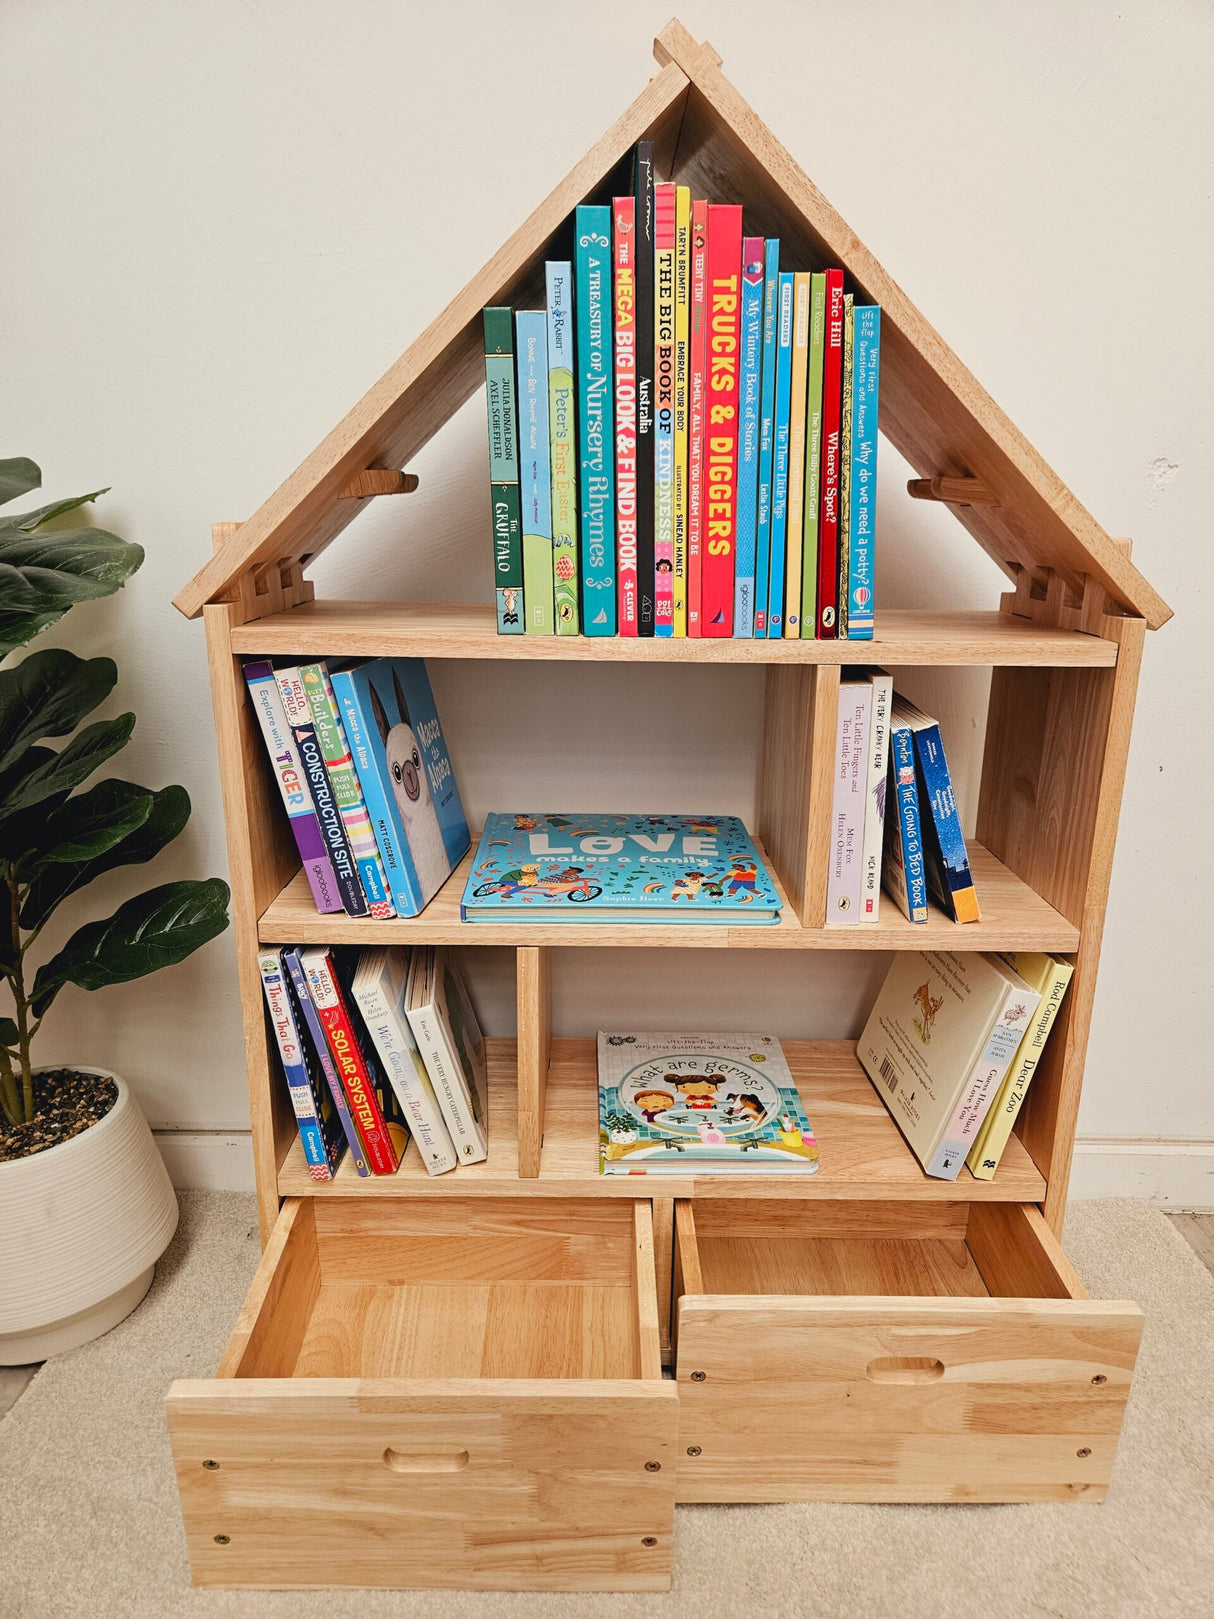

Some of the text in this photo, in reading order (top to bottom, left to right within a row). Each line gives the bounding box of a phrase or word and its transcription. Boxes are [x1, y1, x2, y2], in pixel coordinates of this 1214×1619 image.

[551, 277, 564, 306] PETER
[678, 227, 686, 305] TARYN BRUMFITT
[694, 282, 704, 303] TINY
[696, 252, 704, 280] TEENY
[765, 280, 775, 344] Whoever You Are
[813, 292, 823, 345] First Readers
[830, 287, 842, 348] Eric Hill
[744, 300, 759, 462] My Wintery Book of Stories
[868, 348, 878, 368] Very
[582, 257, 608, 568] A TREASURY OF Nursery Rhymes
[616, 242, 637, 571] THE MEGA BIG LOOK & FIND BOOK
[639, 376, 652, 434] Australia
[658, 254, 672, 540] THE BIG BOOK OF KINDNESS
[676, 341, 685, 432] EMBRACE YOUR BODY
[858, 340, 867, 438] Questions and Answers
[490, 380, 502, 460] AXEL SCHEFFLER
[501, 378, 512, 461] JULIA DONALDSON
[708, 275, 737, 556] TRUCKS & DIGGERS
[762, 418, 770, 451] Mem Fox
[810, 428, 818, 452] Three
[555, 388, 570, 524] Peter's First Easter
[690, 372, 701, 555] FAMILY, ALL THAT YOU DREAM IT TO BE
[774, 424, 788, 518] The Three Little Pigs
[808, 454, 818, 473] Billy
[824, 431, 838, 523] Where's Spot?
[854, 442, 872, 464] Why
[858, 468, 872, 482] do
[760, 484, 768, 524] Leslie Staub
[808, 499, 816, 520] Gruff
[857, 507, 870, 534] need
[858, 486, 868, 503] we
[496, 502, 510, 572] GRUFFALO
[675, 514, 684, 578] SINEAD HANLEY
[852, 548, 870, 585] potty?
[740, 584, 750, 630] igloobooks
[292, 680, 306, 710] HELLO,
[310, 694, 334, 749] Builders
[855, 704, 864, 720] Ten
[878, 690, 886, 702] THE
[259, 690, 305, 806] Explore with TIGER
[840, 718, 852, 780] Ten Little Toes
[854, 722, 864, 744] Little
[896, 731, 910, 764] Boynton
[852, 748, 862, 778] Fingers
[302, 742, 353, 880] CONSTRUCTION SITE
[378, 820, 397, 869] MATT COSGROVE
[528, 833, 719, 856] LOVE
[638, 855, 712, 866] family
[901, 786, 923, 906] THE GOING TO BED BOOK
[312, 864, 333, 908] igloobooks
[365, 865, 380, 900] Campbell
[318, 970, 332, 997] HELLO,
[268, 984, 283, 1017] Things
[276, 1018, 290, 1042] That
[283, 1044, 296, 1060] Go
[1032, 981, 1066, 1049] Rod Campbell
[322, 1058, 332, 1076] LOVE
[331, 1030, 376, 1130] SOLAR SYSTEM
[377, 1025, 435, 1146] We're Going on Bear Hunt
[430, 1051, 466, 1136] THE VERY HUNGRY CATERPILLAR
[630, 1060, 764, 1092] What are germs?
[1006, 1058, 1036, 1113] Dear Zoo
[958, 1084, 980, 1121] Love You
[962, 1068, 998, 1134] Guess How Much
[306, 1132, 320, 1162] Campbell
